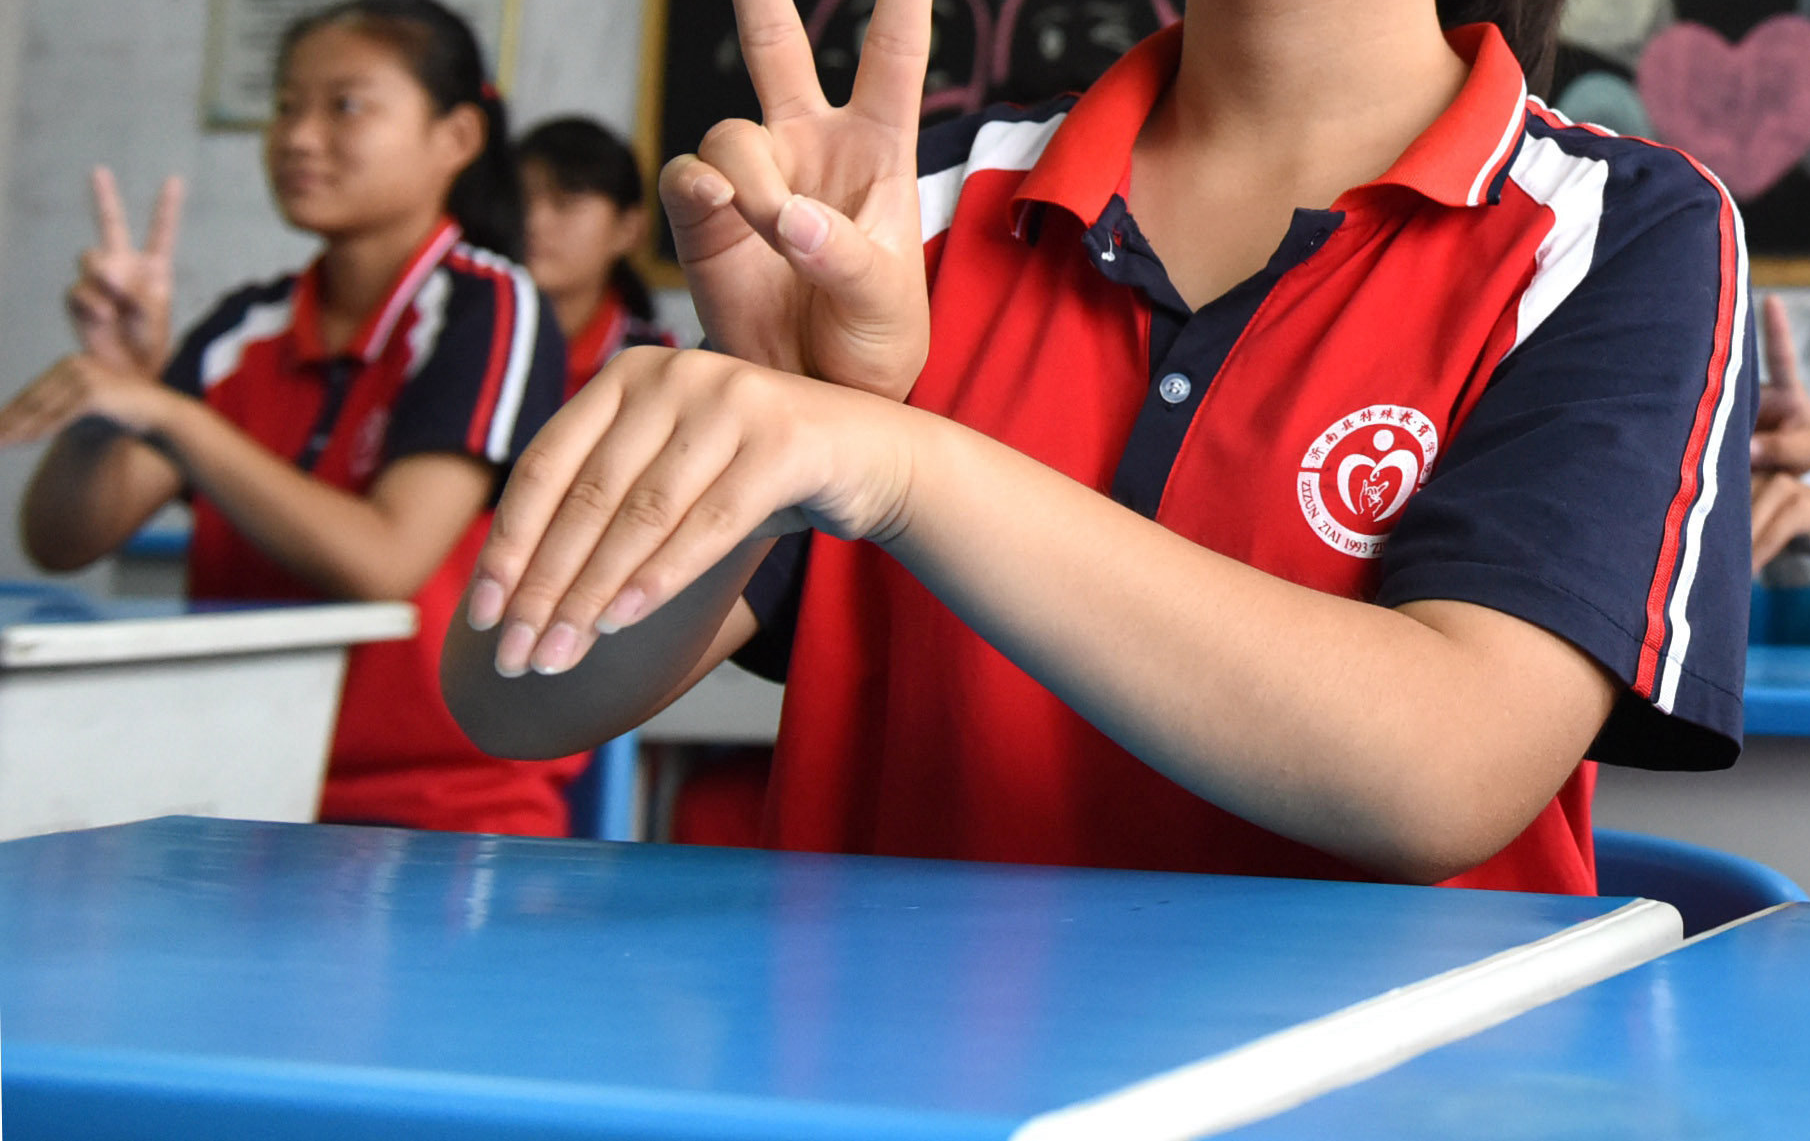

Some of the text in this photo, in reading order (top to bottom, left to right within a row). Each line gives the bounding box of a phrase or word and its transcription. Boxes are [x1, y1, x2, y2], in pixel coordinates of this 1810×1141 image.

[1301, 479, 1320, 520] ZIZUN
[1318, 520, 1342, 545] ZIAI
[1344, 538, 1369, 554] 1993
